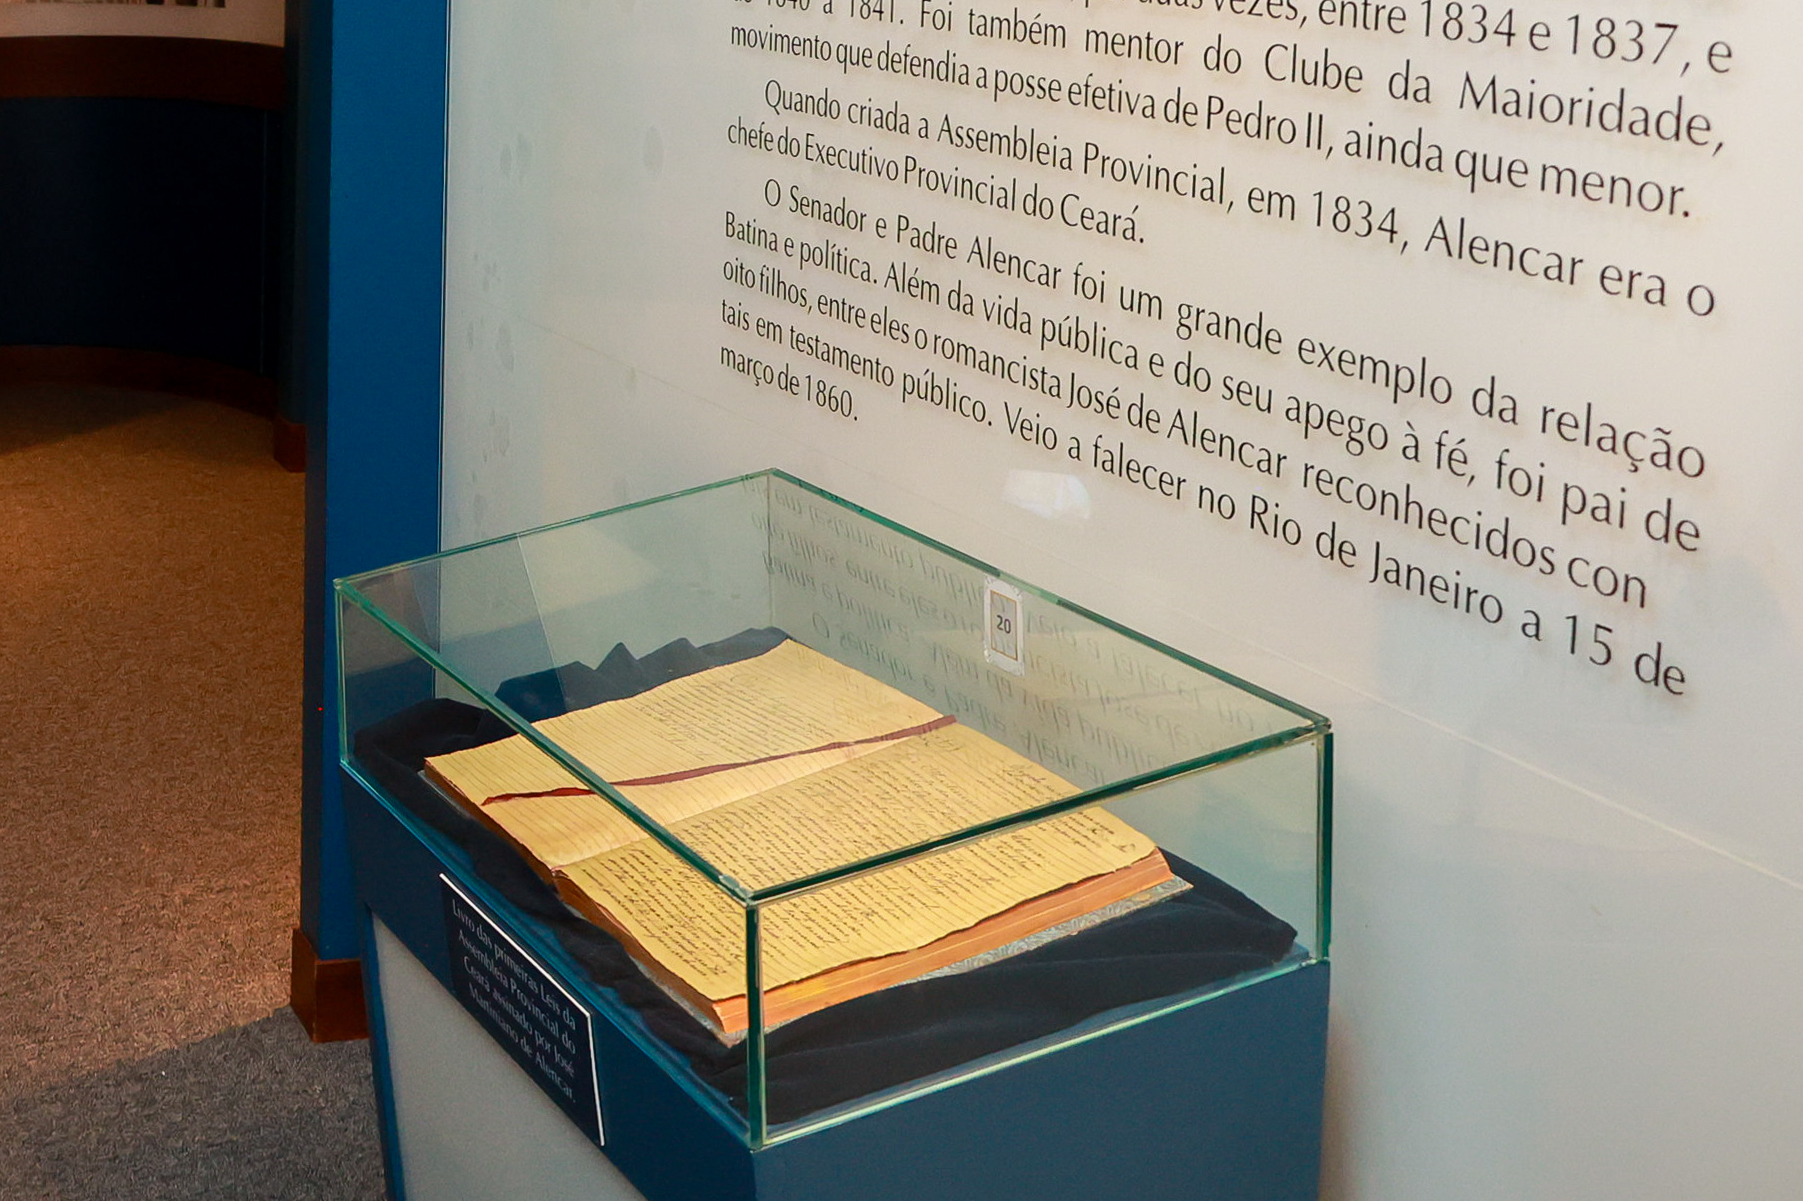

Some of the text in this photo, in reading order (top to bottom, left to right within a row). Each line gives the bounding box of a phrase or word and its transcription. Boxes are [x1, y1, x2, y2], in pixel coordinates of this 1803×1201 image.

[722, 299, 1686, 696] tais em testamento público. Veio a falecer no Rio de Janeiro a 15 de
[996, 614, 1012, 635] 20
[452, 899, 576, 1030] Livro das primeiras Leis da
[492, 988, 533, 1034] assinado
[535, 1029, 551, 1052] por
[554, 1045, 575, 1077] José
[510, 977, 559, 1037] Provincial
[562, 1031, 576, 1054] do
[520, 1036, 533, 1058] de
